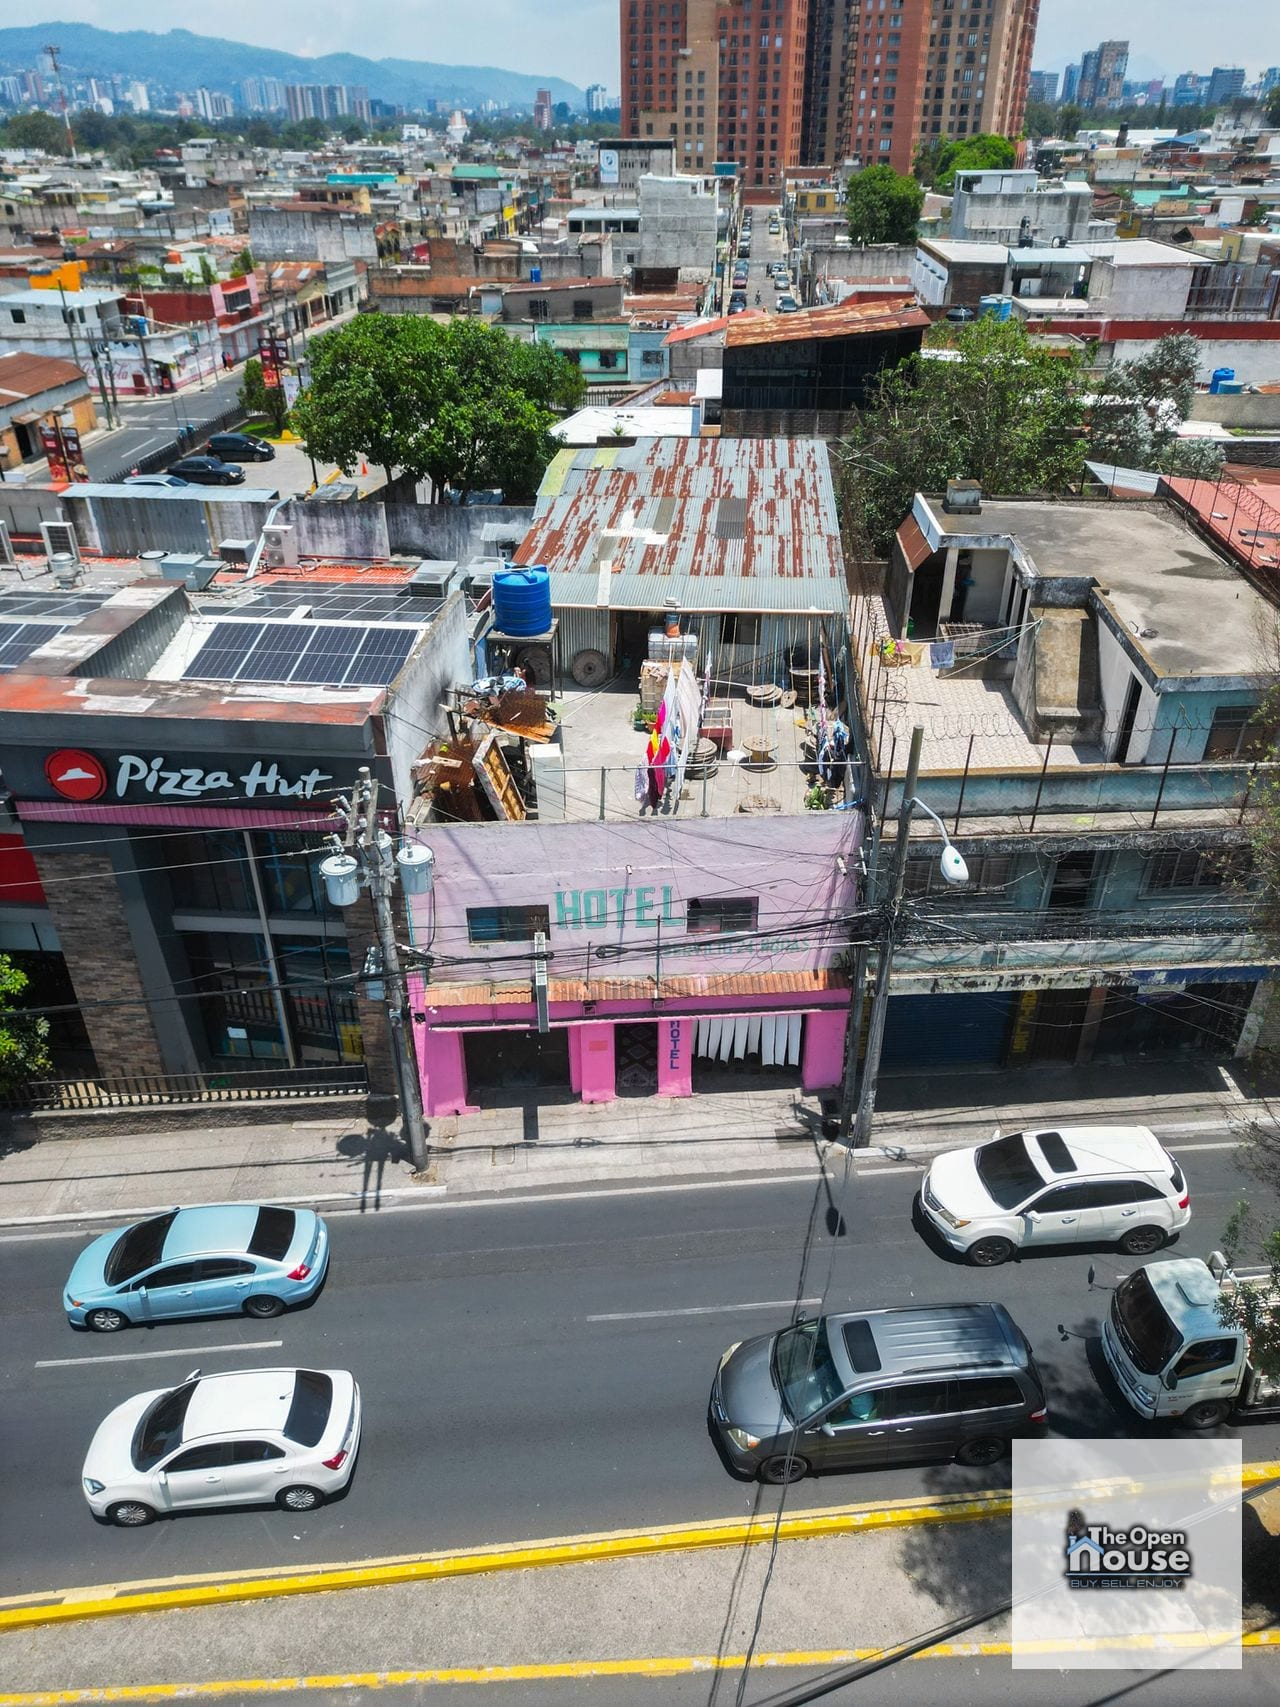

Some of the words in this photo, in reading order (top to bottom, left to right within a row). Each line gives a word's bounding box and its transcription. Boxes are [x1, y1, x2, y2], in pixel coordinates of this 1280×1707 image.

[116, 755, 234, 797] Pizza
[240, 761, 333, 799] Hut
[553, 885, 686, 930] HOTEL
[670, 1020, 681, 1070] HOTEL
